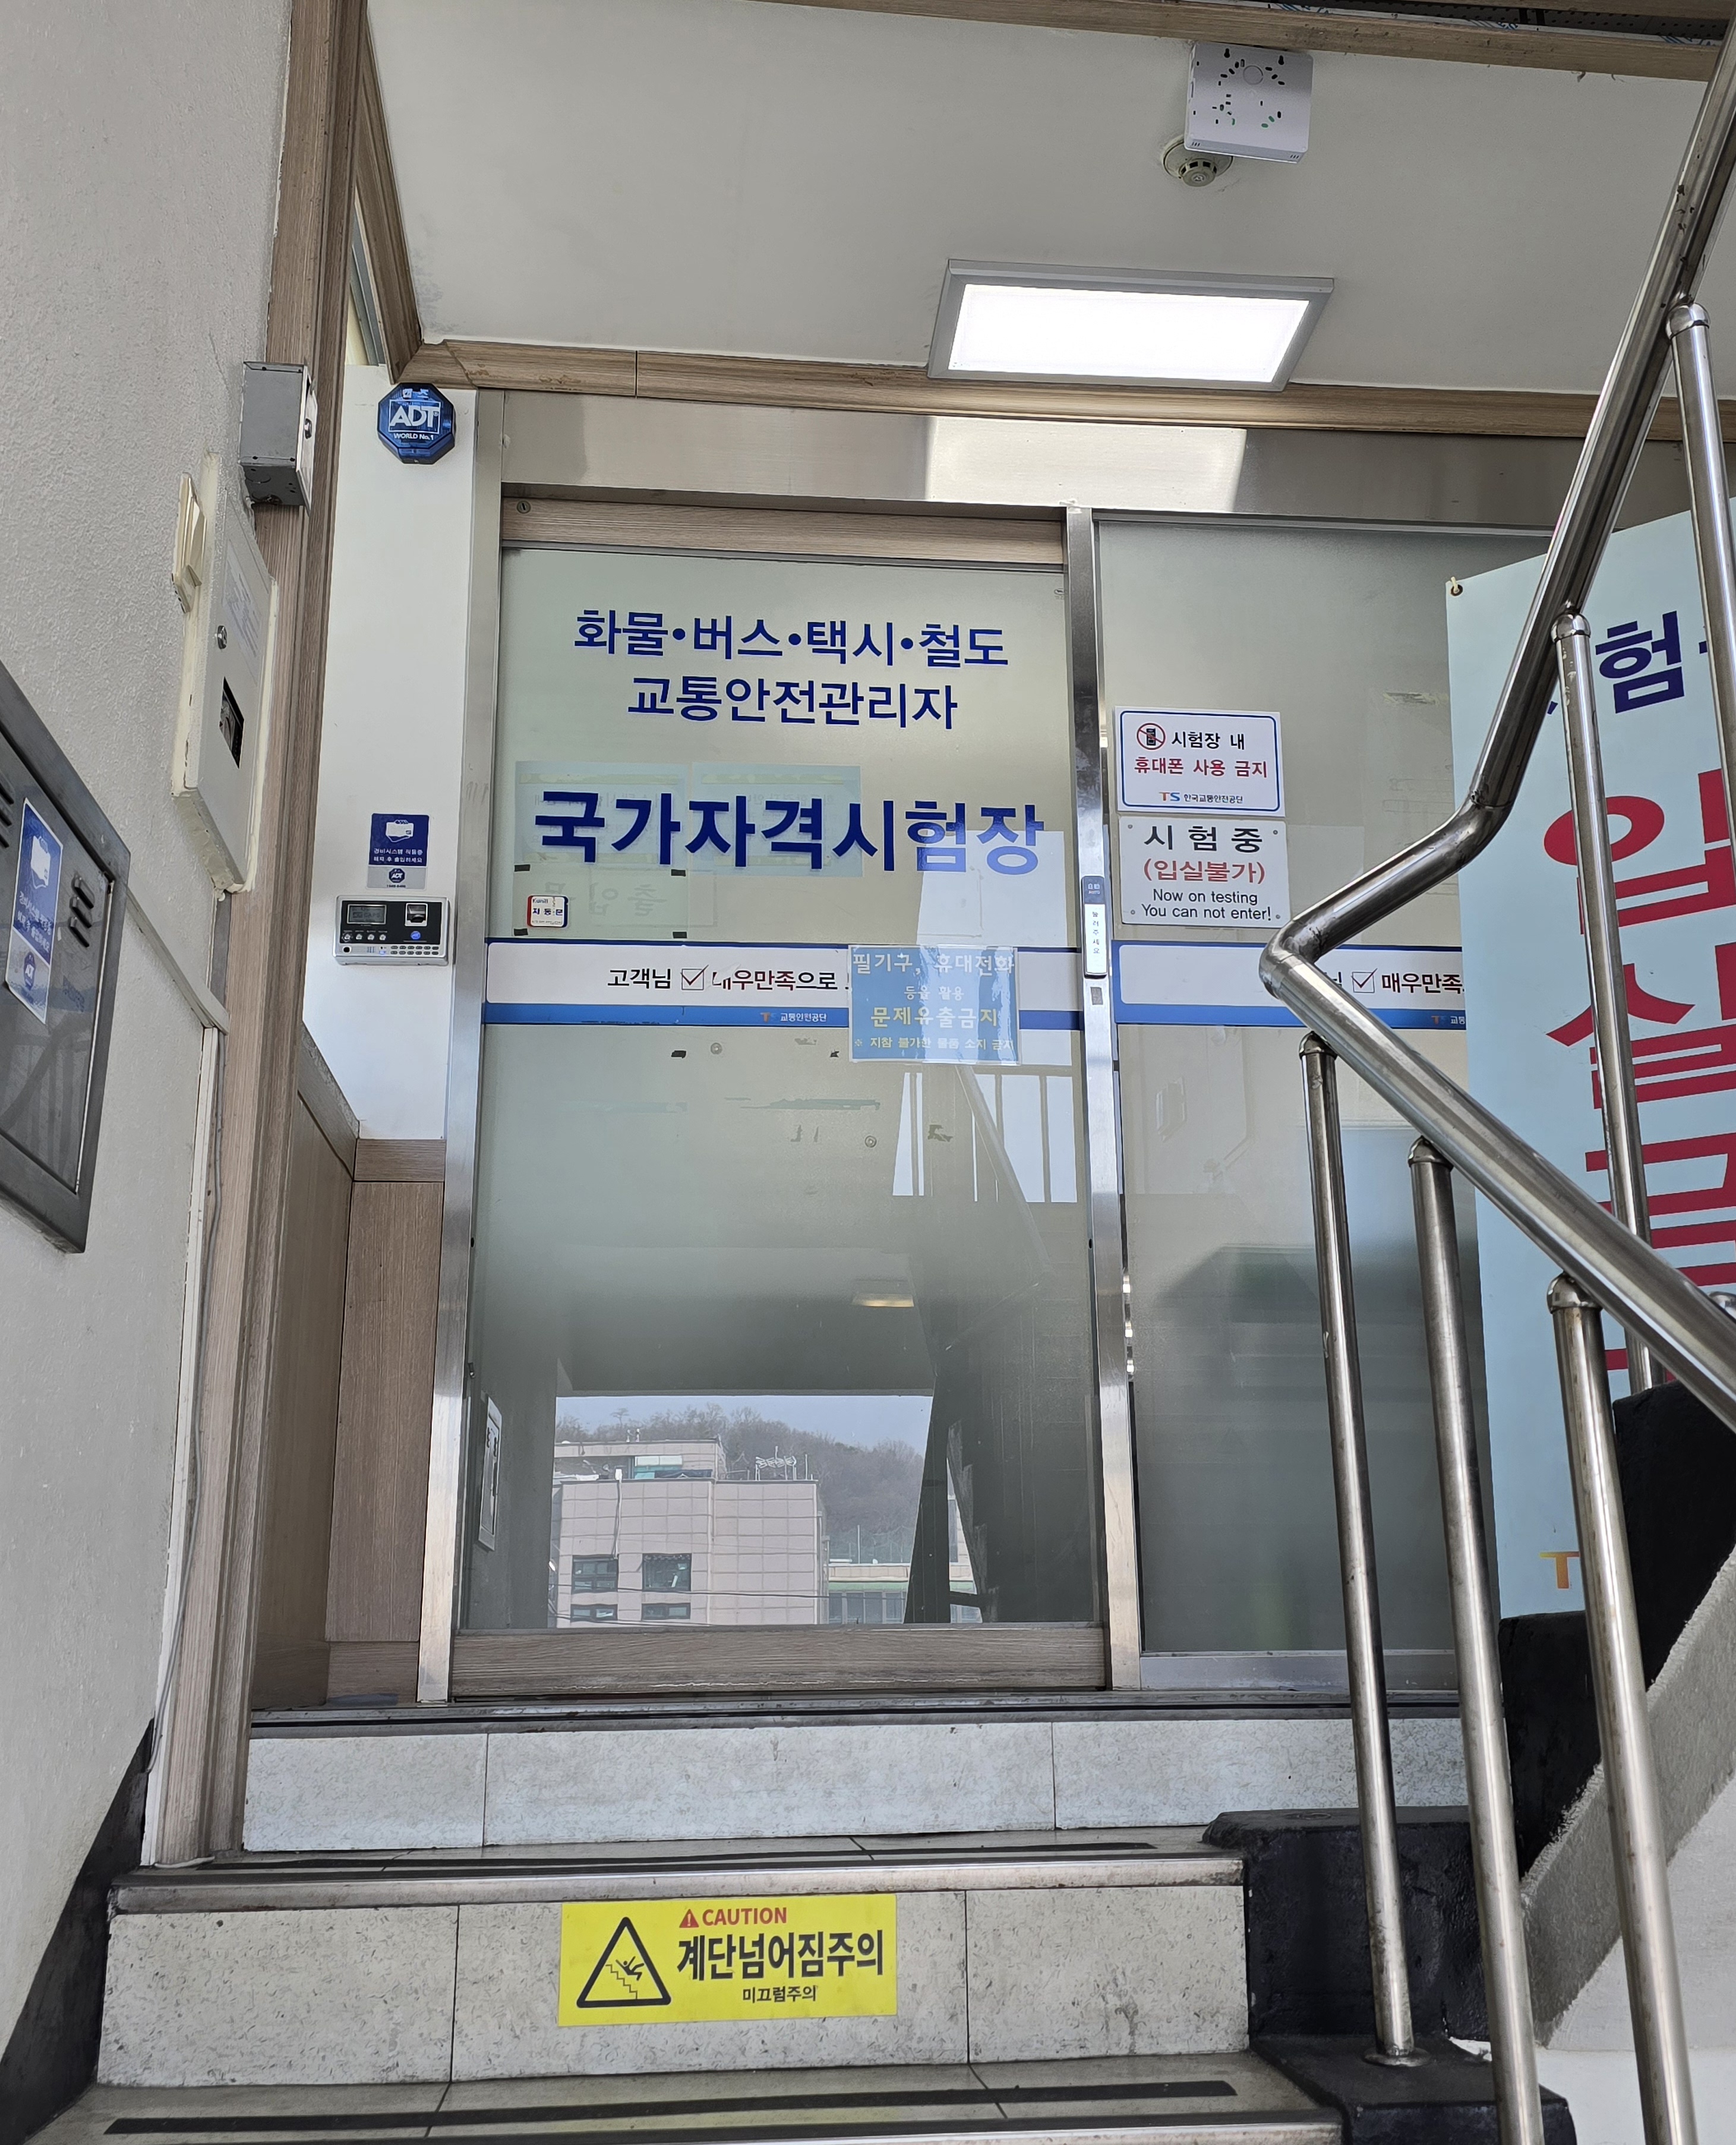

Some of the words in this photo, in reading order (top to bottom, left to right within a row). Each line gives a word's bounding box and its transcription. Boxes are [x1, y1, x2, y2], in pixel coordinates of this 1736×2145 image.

[390, 405, 439, 427] ADT
[627, 676, 957, 729] 교통안전관리자
[1172, 731, 1220, 749] 시험장
[1230, 734, 1245, 750] 내
[1134, 757, 1183, 774] 휴대폰
[1193, 759, 1226, 777] 사용
[1235, 761, 1267, 778] 금지
[1159, 792, 1180, 802] TS
[535, 791, 1044, 875] 국가자격시험장
[1144, 859, 1265, 884] (입실불가)
[1153, 889, 1183, 901] Now
[1188, 891, 1205, 903] on
[1211, 891, 1258, 906] testing
[1141, 904, 1166, 917] You
[1172, 907, 1198, 918] can
[1204, 907, 1226, 919] not
[1230, 907, 1271, 920] enter!
[853, 953, 921, 975] 필기구,
[935, 954, 1015, 976] 휴대전화
[607, 969, 671, 989] 고객님
[904, 986, 930, 1001] 등을
[870, 1007, 998, 1029] 문제유출금지
[870, 1037, 892, 1048] 지참
[964, 1039, 986, 1050] 소지
[702, 1907, 787, 1926] CAUTION
[677, 1929, 883, 1981] 계단넘어짐주의
[743, 1985, 816, 2003] 미끄럼주의
